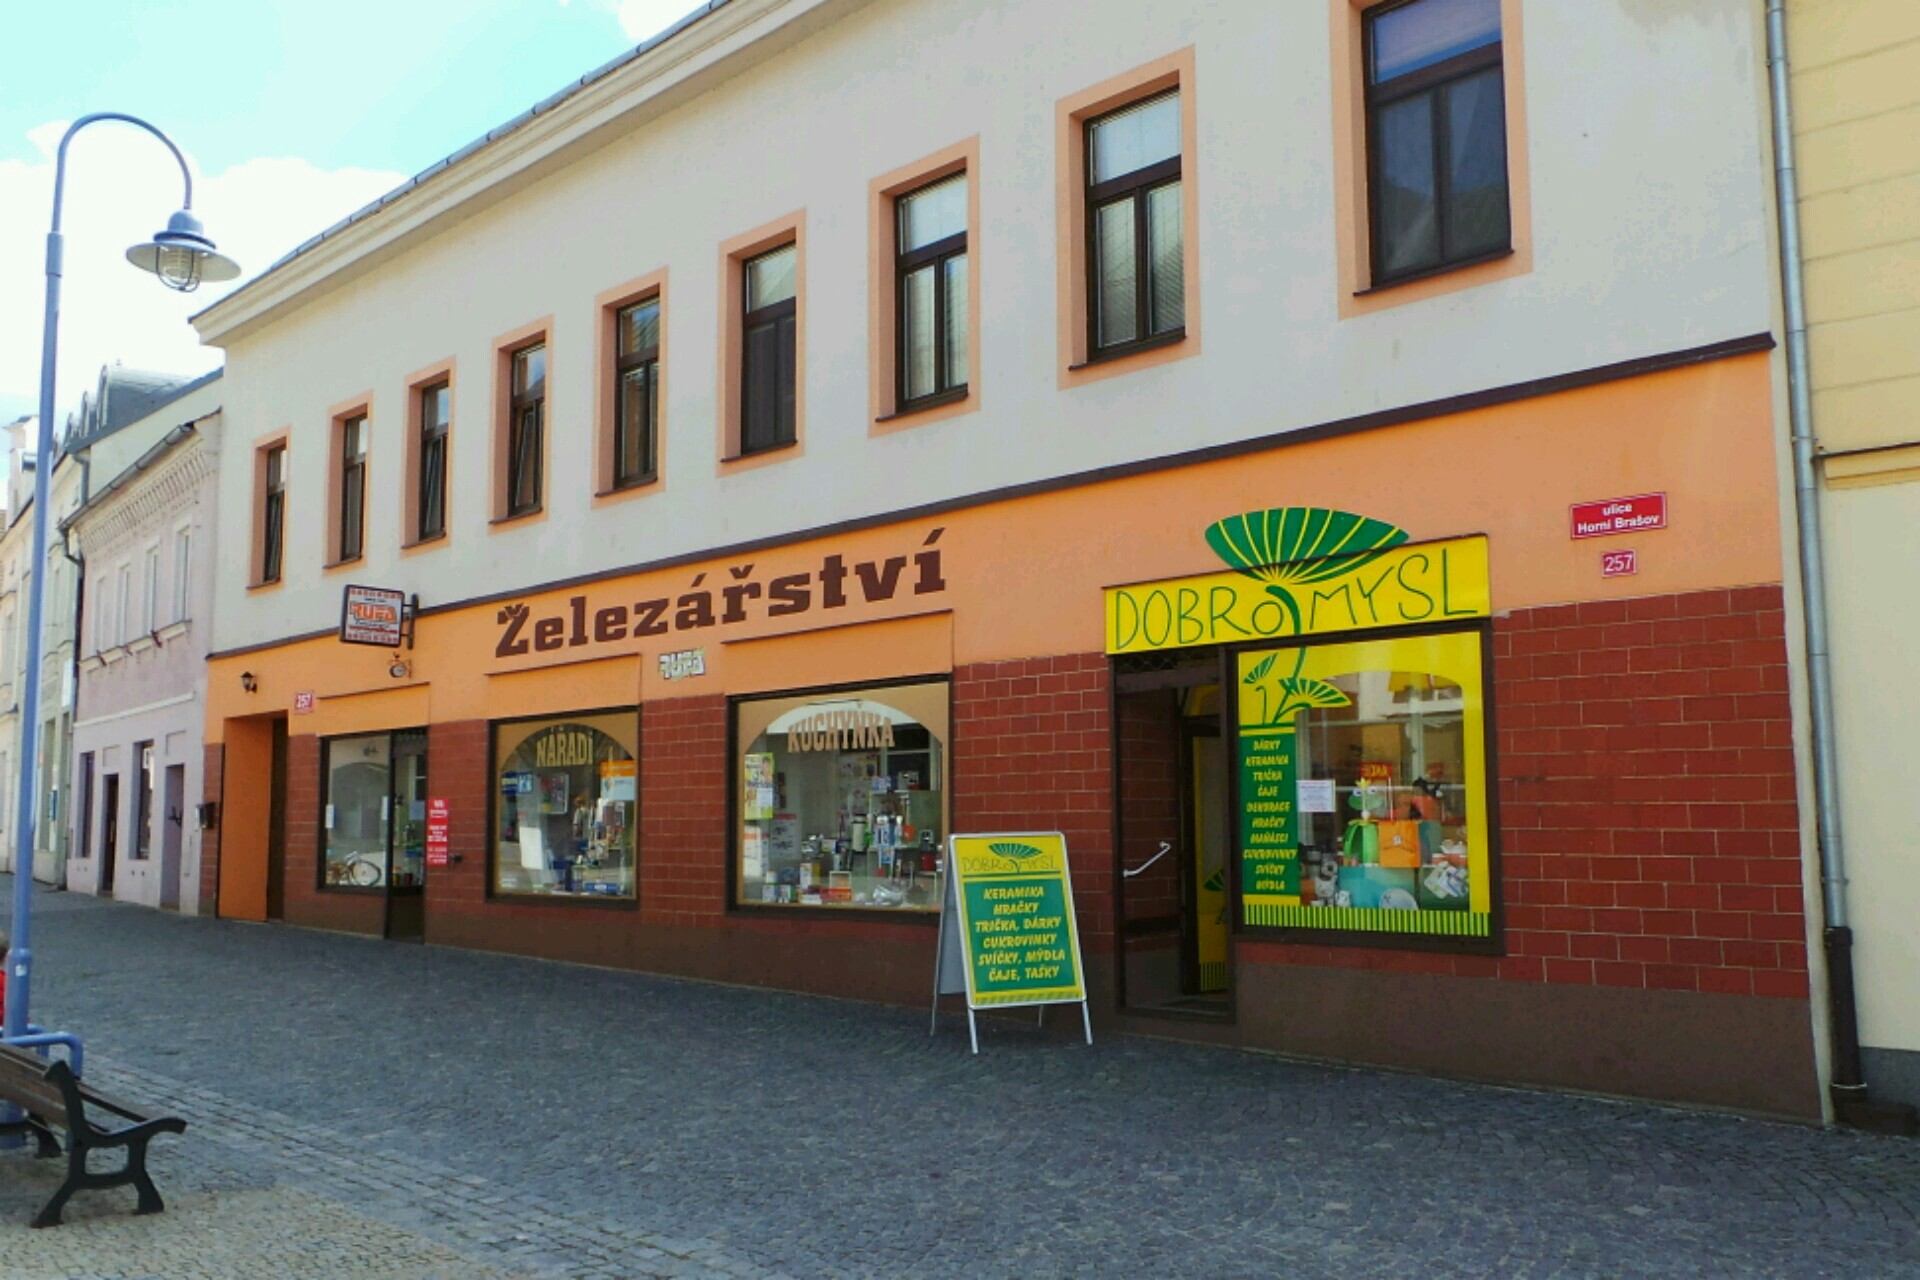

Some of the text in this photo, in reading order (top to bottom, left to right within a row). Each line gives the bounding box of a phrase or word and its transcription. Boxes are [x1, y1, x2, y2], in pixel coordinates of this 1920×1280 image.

[1603, 504, 1633, 516] ulice
[1615, 515, 1660, 529] Brašov
[1605, 554, 1633, 572] 257
[495, 527, 946, 658] Železářství
[1114, 548, 1478, 650] DOBROMYSL
[536, 726, 593, 768] NÁŘADÍ
[983, 887, 1045, 900] KERAMIKA
[993, 902, 1040, 915] HRAČKY
[975, 915, 1061, 932] TRIČKA, DÁRKY
[983, 934, 1057, 949] CUKROVINKY
[978, 949, 1066, 966] SVÍČKY, MÝDLA
[988, 965, 1060, 982] ČAJE, TAŠKY
